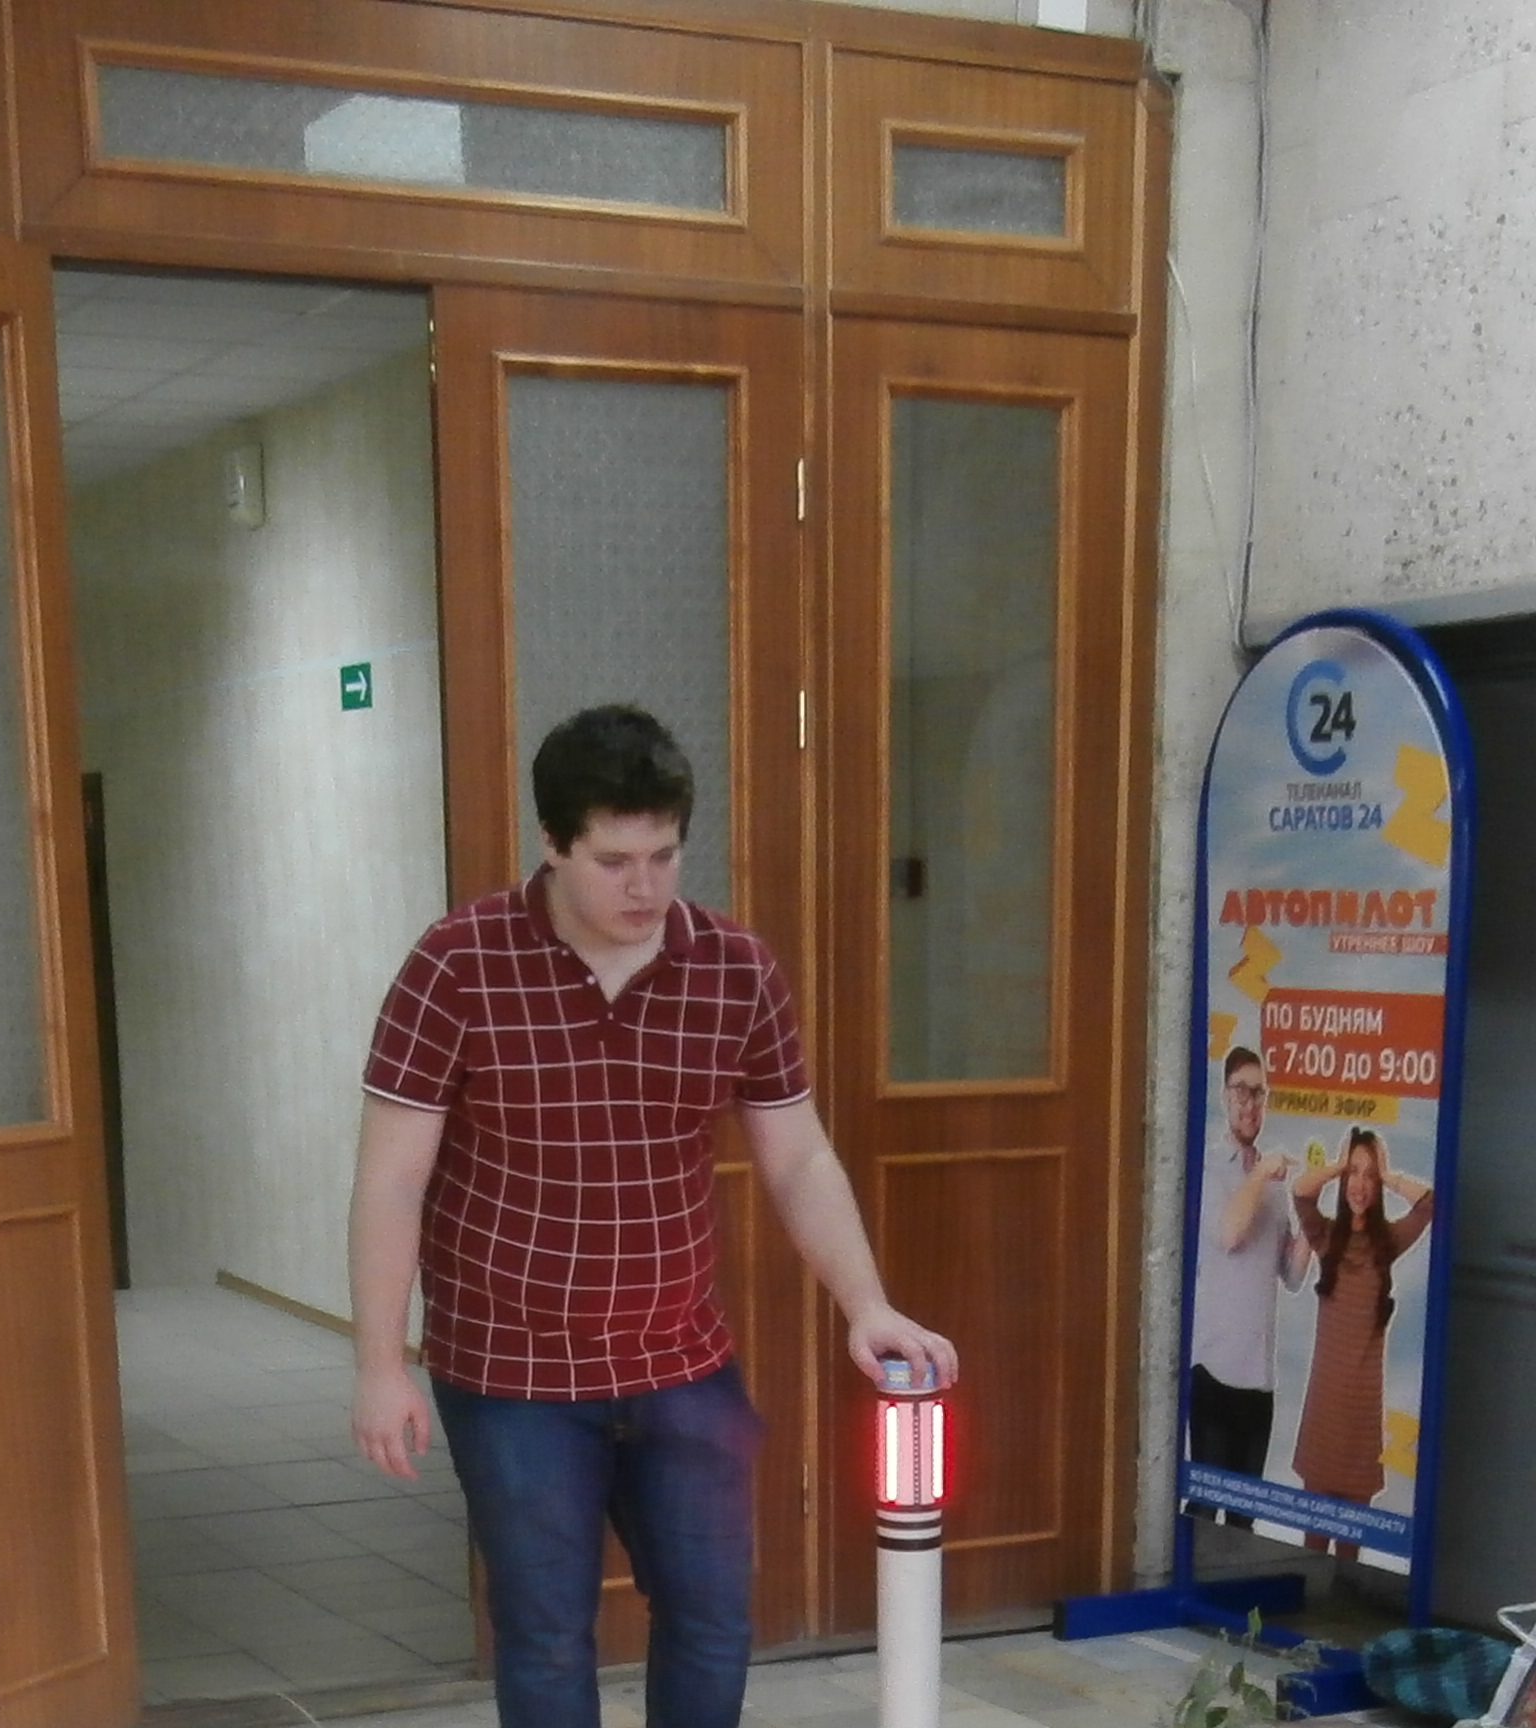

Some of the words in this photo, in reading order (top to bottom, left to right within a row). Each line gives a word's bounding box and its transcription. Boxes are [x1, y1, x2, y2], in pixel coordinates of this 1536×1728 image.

[1309, 690, 1357, 743] 24
[1269, 805, 1353, 832] САРАТОВ
[1358, 803, 1383, 830] 24
[1220, 888, 1438, 928] АВТОПИЛОТ
[1266, 1002, 1293, 1030] ПО
[1300, 1005, 1384, 1037] БУДНЯМ
[1283, 1042, 1336, 1078] 7:00
[1341, 1052, 1372, 1085] до
[1379, 1047, 1437, 1086] 9:00
[1333, 1096, 1377, 1118] ЭФИР
